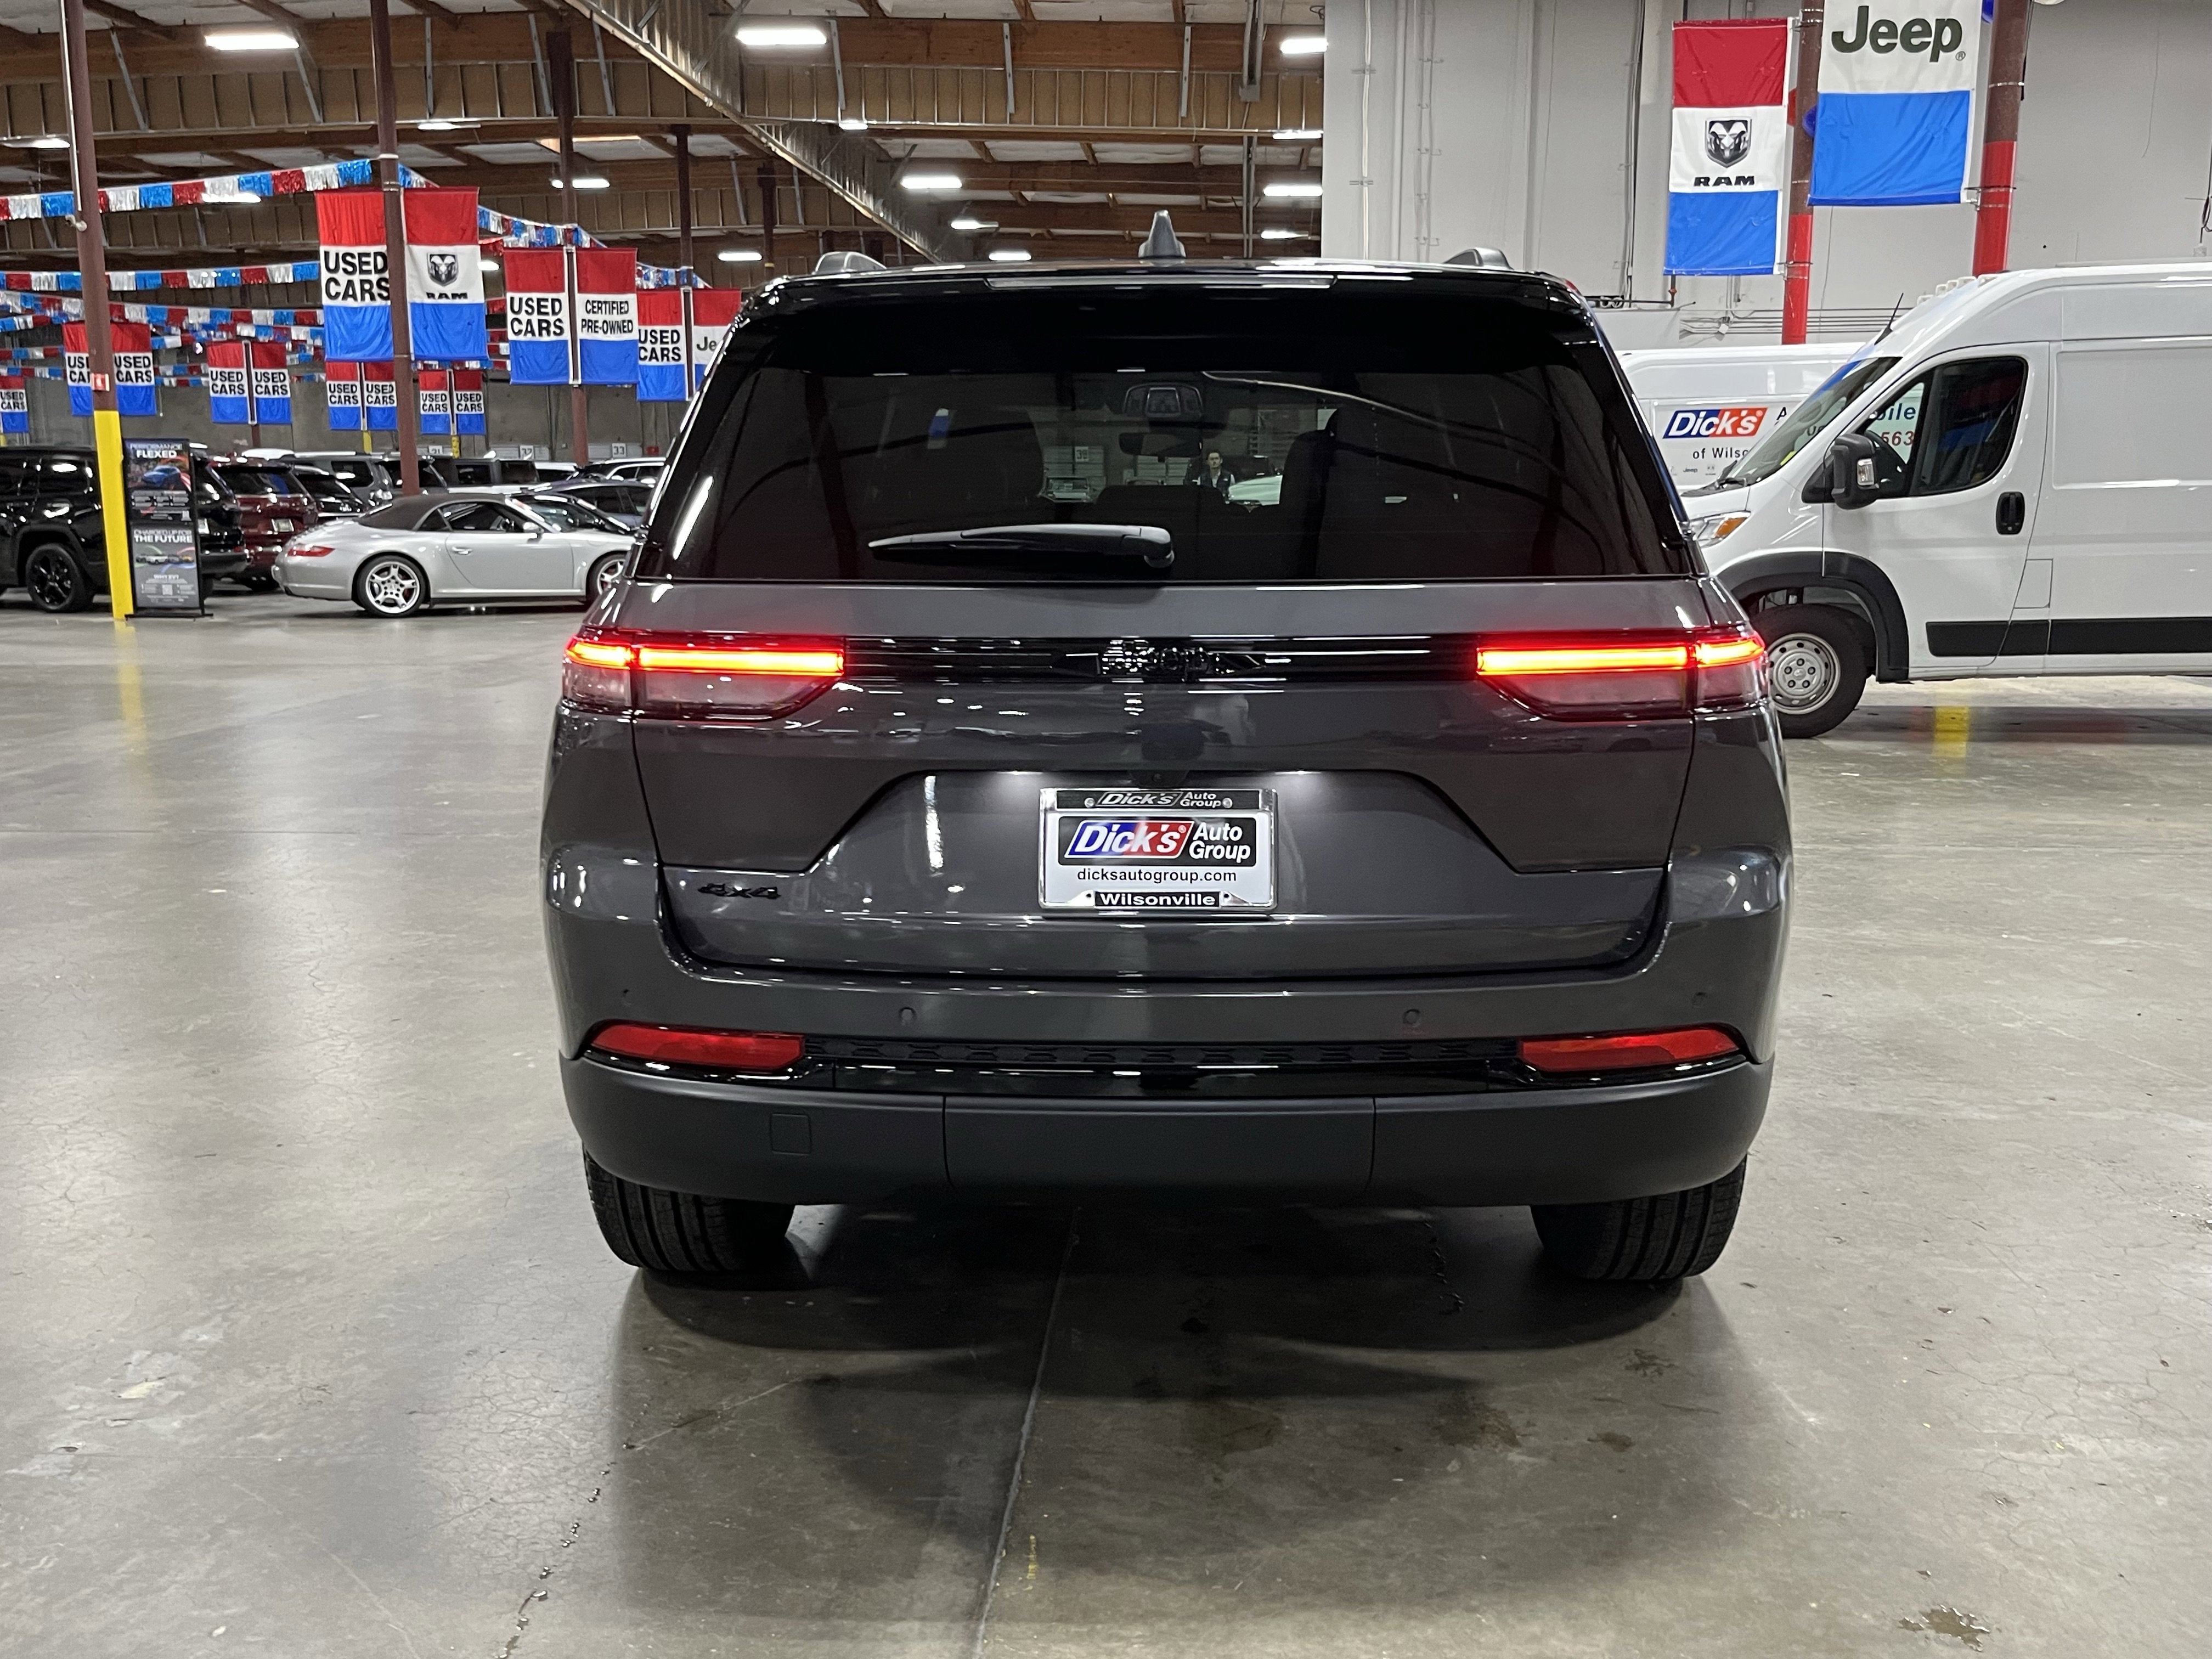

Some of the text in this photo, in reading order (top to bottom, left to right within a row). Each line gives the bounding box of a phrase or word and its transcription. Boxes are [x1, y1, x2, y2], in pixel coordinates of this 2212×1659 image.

[1831, 5, 1962, 63] Jeep
[1693, 175, 1756, 187] RAM
[324, 251, 388, 275] USED
[325, 277, 390, 301] CARS
[510, 297, 562, 316] USED
[585, 300, 629, 315] CERTIFIED
[510, 318, 565, 337] CARS
[581, 318, 634, 335] PRE-OWNED
[638, 329, 681, 345] USED
[638, 346, 681, 362] CARS
[114, 356, 151, 369] USED
[116, 370, 152, 383] CARS
[210, 370, 243, 382] USED
[255, 371, 286, 383] USED
[211, 384, 245, 395] CARS
[255, 385, 288, 396] CARS
[329, 383, 357, 393] USED
[366, 383, 394, 394] USED
[0, 391, 24, 400] USED
[329, 394, 358, 404] CARS
[366, 394, 395, 405] CARS
[422, 393, 447, 402] USED
[456, 393, 482, 402] USED
[1, 401, 25, 410] CARS
[422, 403, 448, 413] CARS
[456, 403, 483, 413] CARS
[1668, 410, 1758, 436] Dick's
[136, 450, 177, 458] FLEXED
[613, 446, 625, 455] 33
[1692, 448, 1706, 459] of
[1099, 792, 1216, 805] Dick's Auto
[1180, 799, 1222, 808] Group
[1074, 822, 1243, 854] Dick's Auto
[1189, 842, 1251, 863] Group
[1077, 868, 1237, 884] dicksautogroup.com
[1099, 893, 1216, 906] Wilsonville
